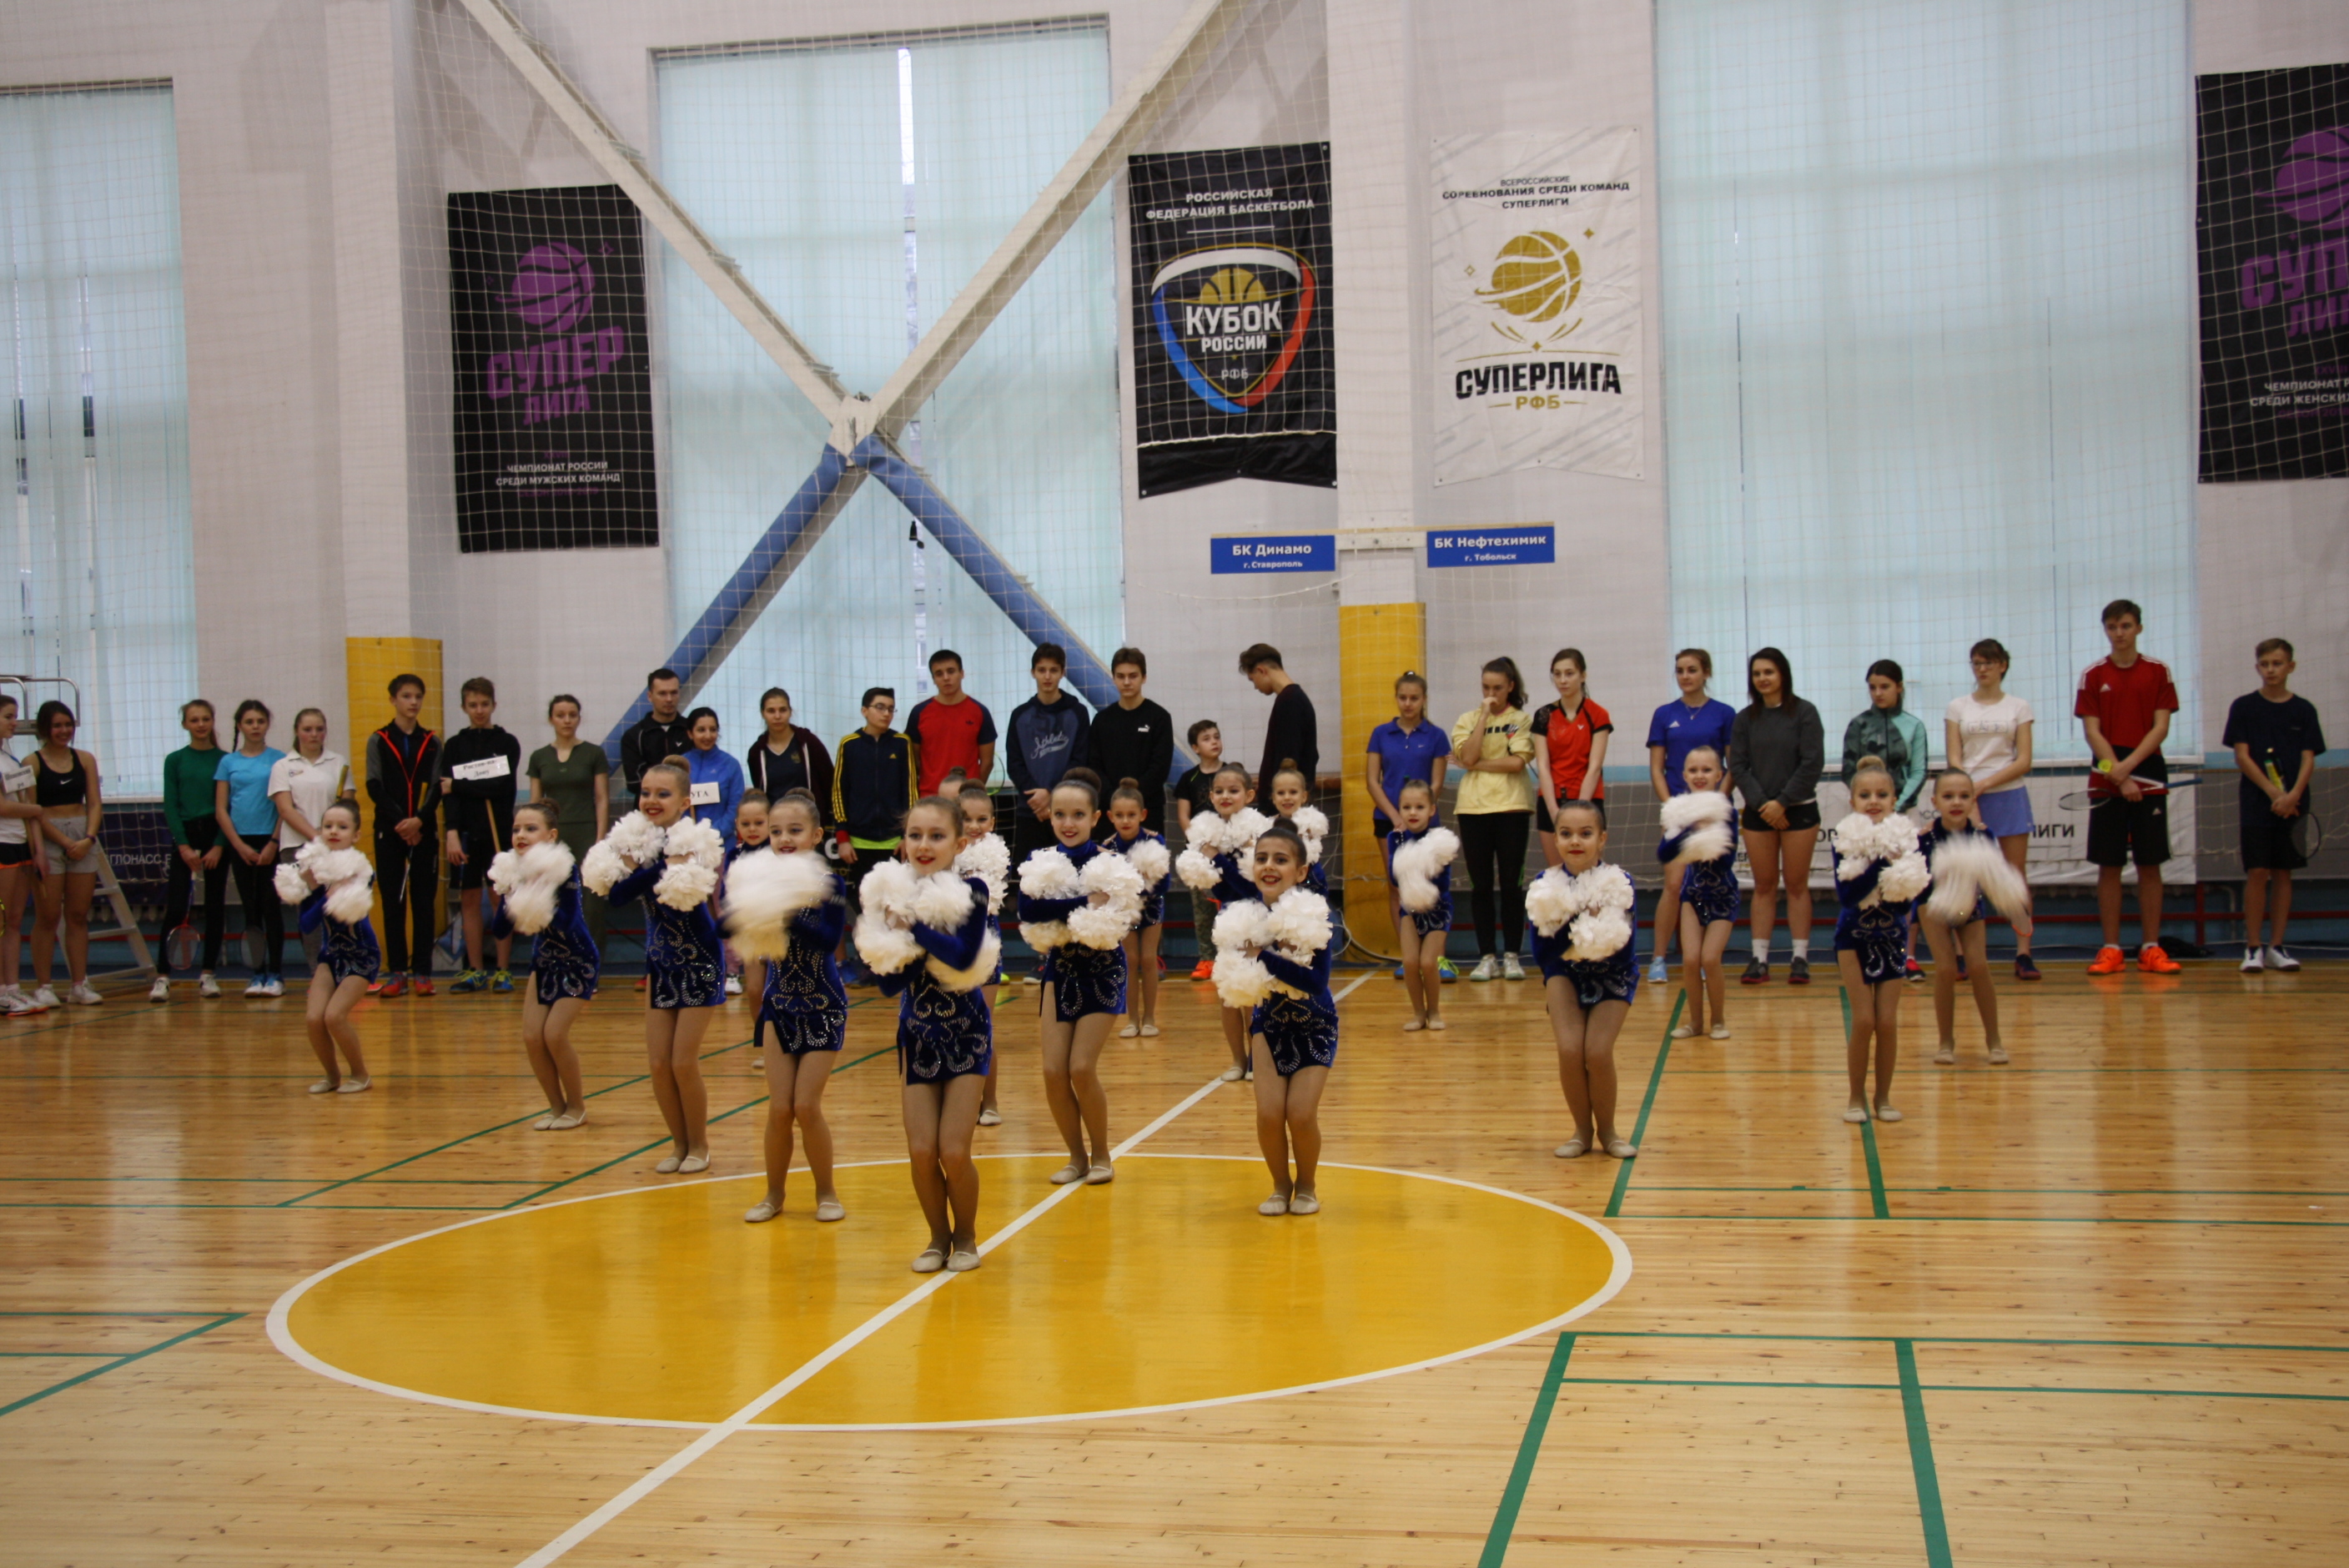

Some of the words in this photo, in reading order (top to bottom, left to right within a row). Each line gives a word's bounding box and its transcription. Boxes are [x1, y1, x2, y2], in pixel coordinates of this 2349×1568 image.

[1500, 175, 1571, 187] ВСЕРОССИЙСКИЕ
[1185, 188, 1274, 203] РОССИЙСКАЯ
[1442, 186, 1535, 199] СОРЕВНОВАНИЯ
[1538, 184, 1577, 197] СРЕДИ
[1581, 181, 1630, 193] КОМАНД
[1145, 205, 1225, 220] ФЕДЕРАЦИЯ
[1229, 199, 1315, 216] БАСКЕТБОЛА
[1501, 197, 1569, 209] СУПЕРЛИГИ
[2241, 237, 2349, 310] СУП
[1186, 300, 1282, 335] КУБОК
[1201, 334, 1267, 353] РОССИИ
[486, 325, 624, 400] СУПЕР
[1221, 368, 1249, 380] РФБ
[1455, 361, 1622, 400] СУПЕРЛИГА
[2264, 379, 2341, 391] ЧЕМПИОНАТ
[522, 384, 591, 425] ЛИГА
[1516, 395, 1561, 410] РФБ
[2250, 396, 2291, 406] СРЕДИ
[507, 463, 566, 474] ЧЕМПИОНАТ
[568, 460, 608, 470] РОССИИ
[495, 477, 527, 486] СРЕДИ
[529, 475, 577, 485] МУЖСКИХ
[579, 473, 621, 483] КОМАНД
[1434, 537, 1453, 549] БК
[1457, 535, 1547, 549] Нефтехимик
[1232, 545, 1251, 556] БК
[1255, 543, 1312, 557] Динамо
[1475, 553, 1517, 562] Тобольск
